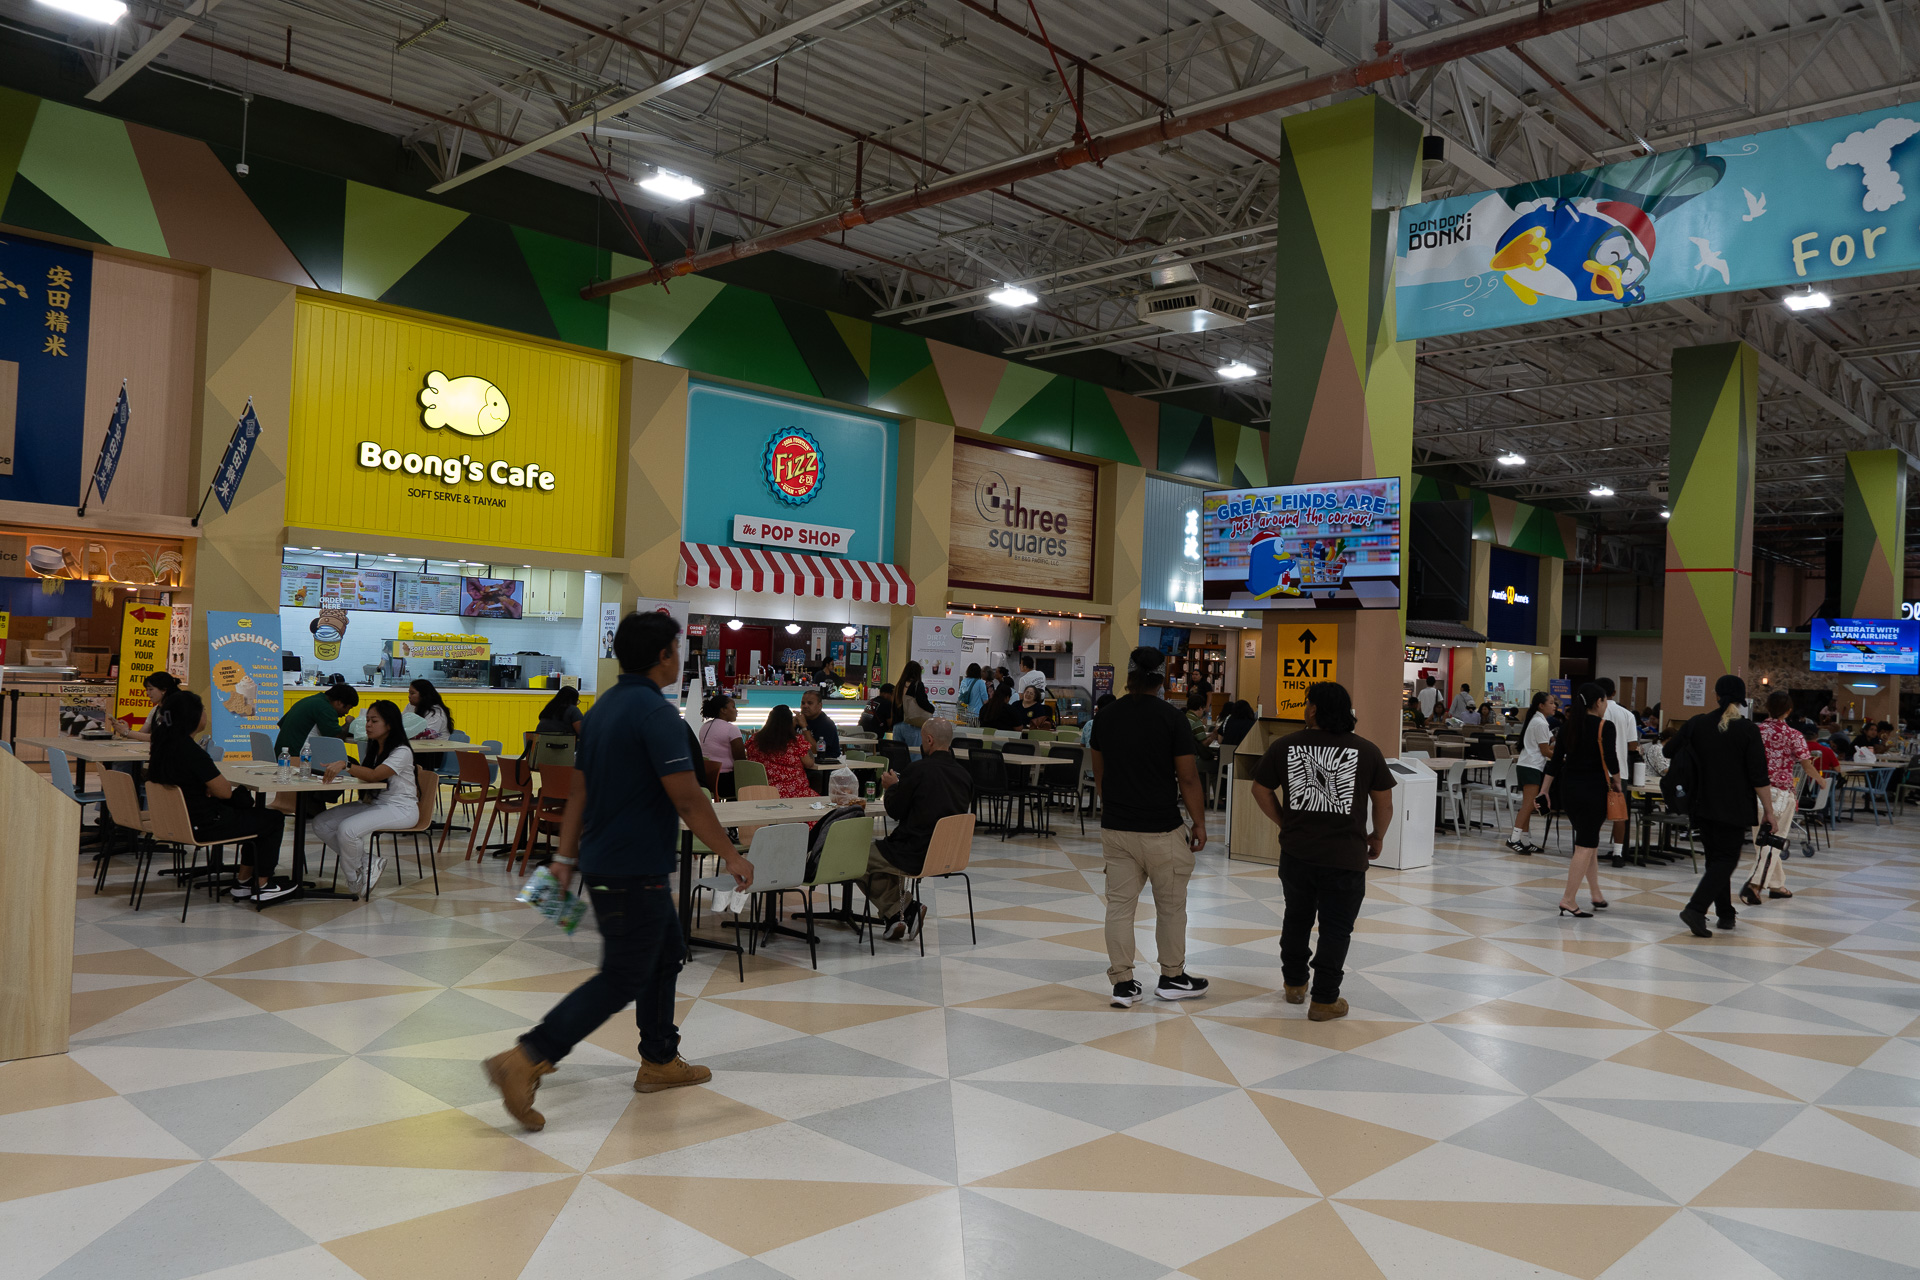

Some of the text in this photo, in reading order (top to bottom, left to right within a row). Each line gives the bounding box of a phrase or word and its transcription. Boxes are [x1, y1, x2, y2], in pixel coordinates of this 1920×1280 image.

[1409, 213, 1465, 234] DON DON
[1792, 226, 1887, 276] For
[42, 265, 73, 358] 安田精米
[359, 440, 556, 491] Boong's Cafe
[775, 452, 818, 483] Fizz
[799, 475, 806, 484] &
[407, 488, 507, 508] SOFT SERVE & TAIYAKI
[1217, 493, 1388, 521] GREAT FINDS ARE
[1001, 486, 1068, 535] three
[1230, 507, 1373, 540] just around the corner!
[742, 523, 841, 547] the POP SHOP
[988, 528, 1067, 558] squares
[1491, 590, 1530, 604] Auntie Anne's
[134, 627, 159, 637] PLEASE
[1829, 625, 1875, 633] CELEBRATE
[1830, 632, 1860, 640] JAPAN
[134, 639, 156, 648] PLACE
[210, 632, 280, 654] MILKSHAKE
[134, 651, 154, 660] YOUR
[130, 663, 155, 672] ORDER
[1283, 659, 1333, 678] EXIT
[129, 675, 139, 683] AT
[1282, 681, 1306, 690] THIS
